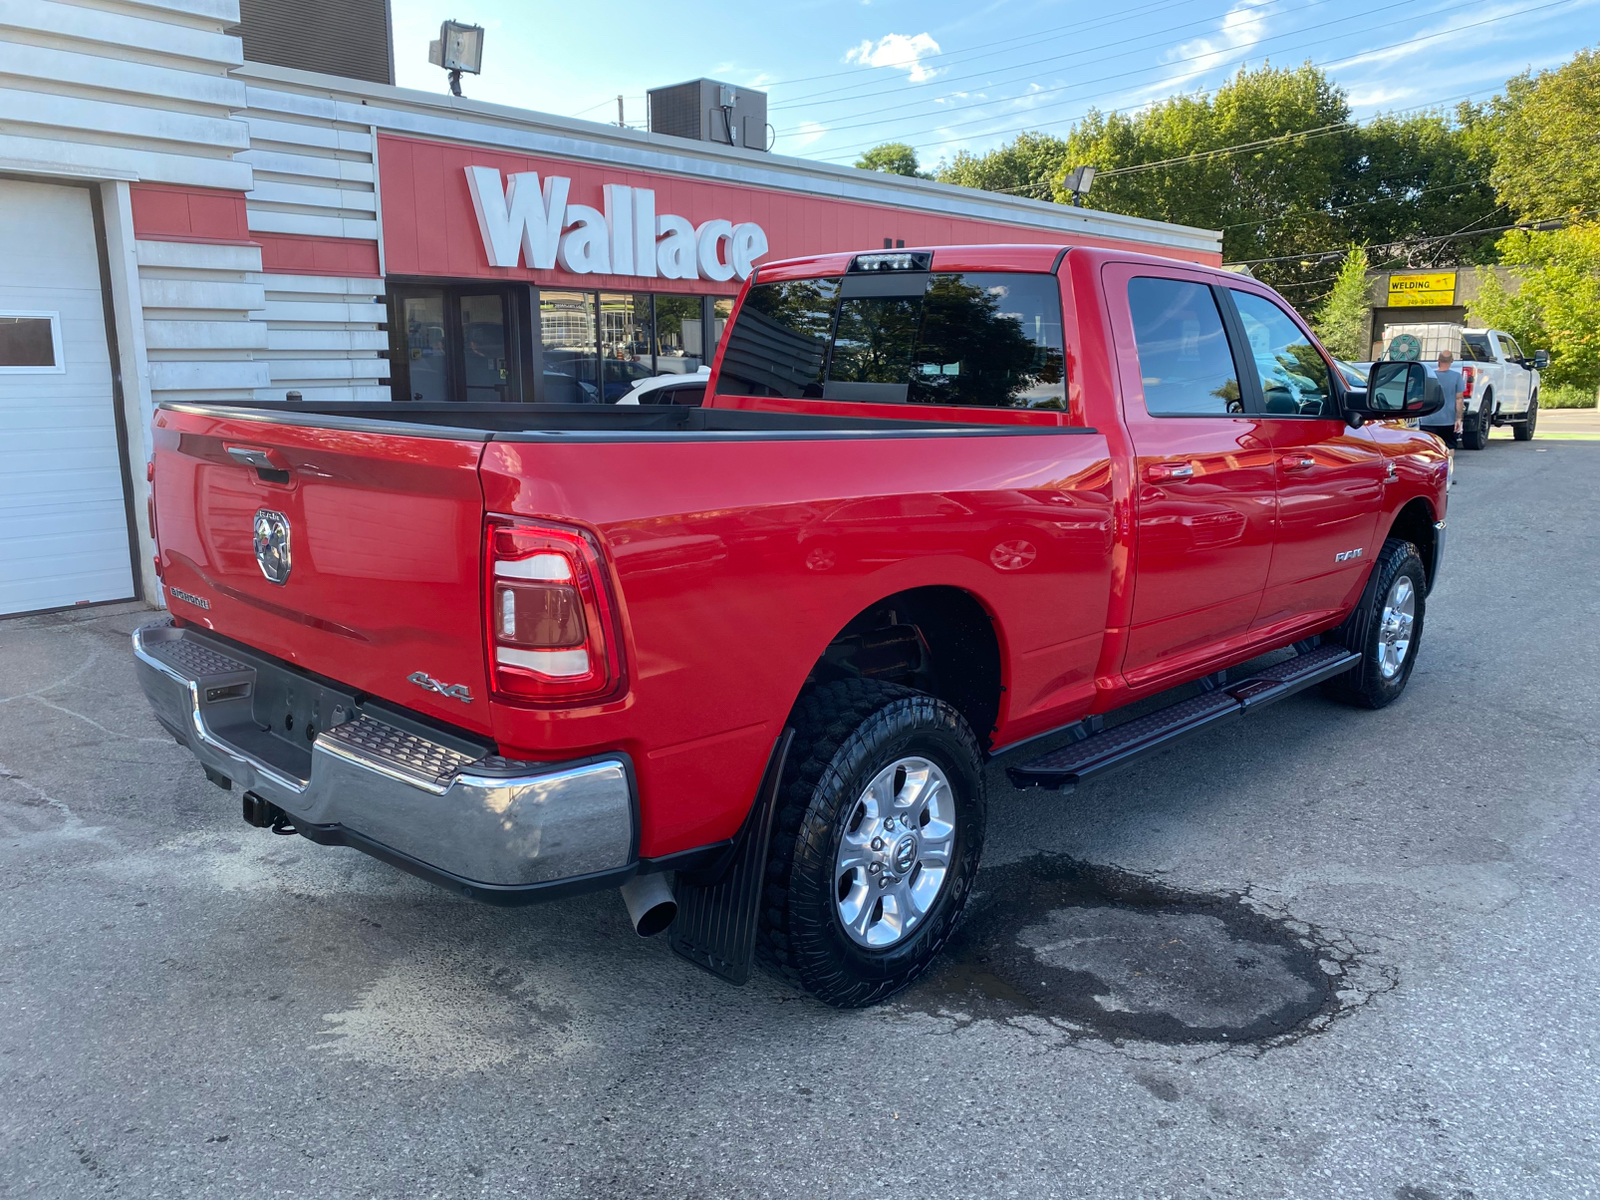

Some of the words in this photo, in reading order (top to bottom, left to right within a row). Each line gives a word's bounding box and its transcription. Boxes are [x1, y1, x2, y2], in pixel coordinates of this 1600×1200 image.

[464, 165, 769, 282] Wallace
[1392, 281, 1430, 290] WELDING
[1335, 547, 1363, 563] RAM
